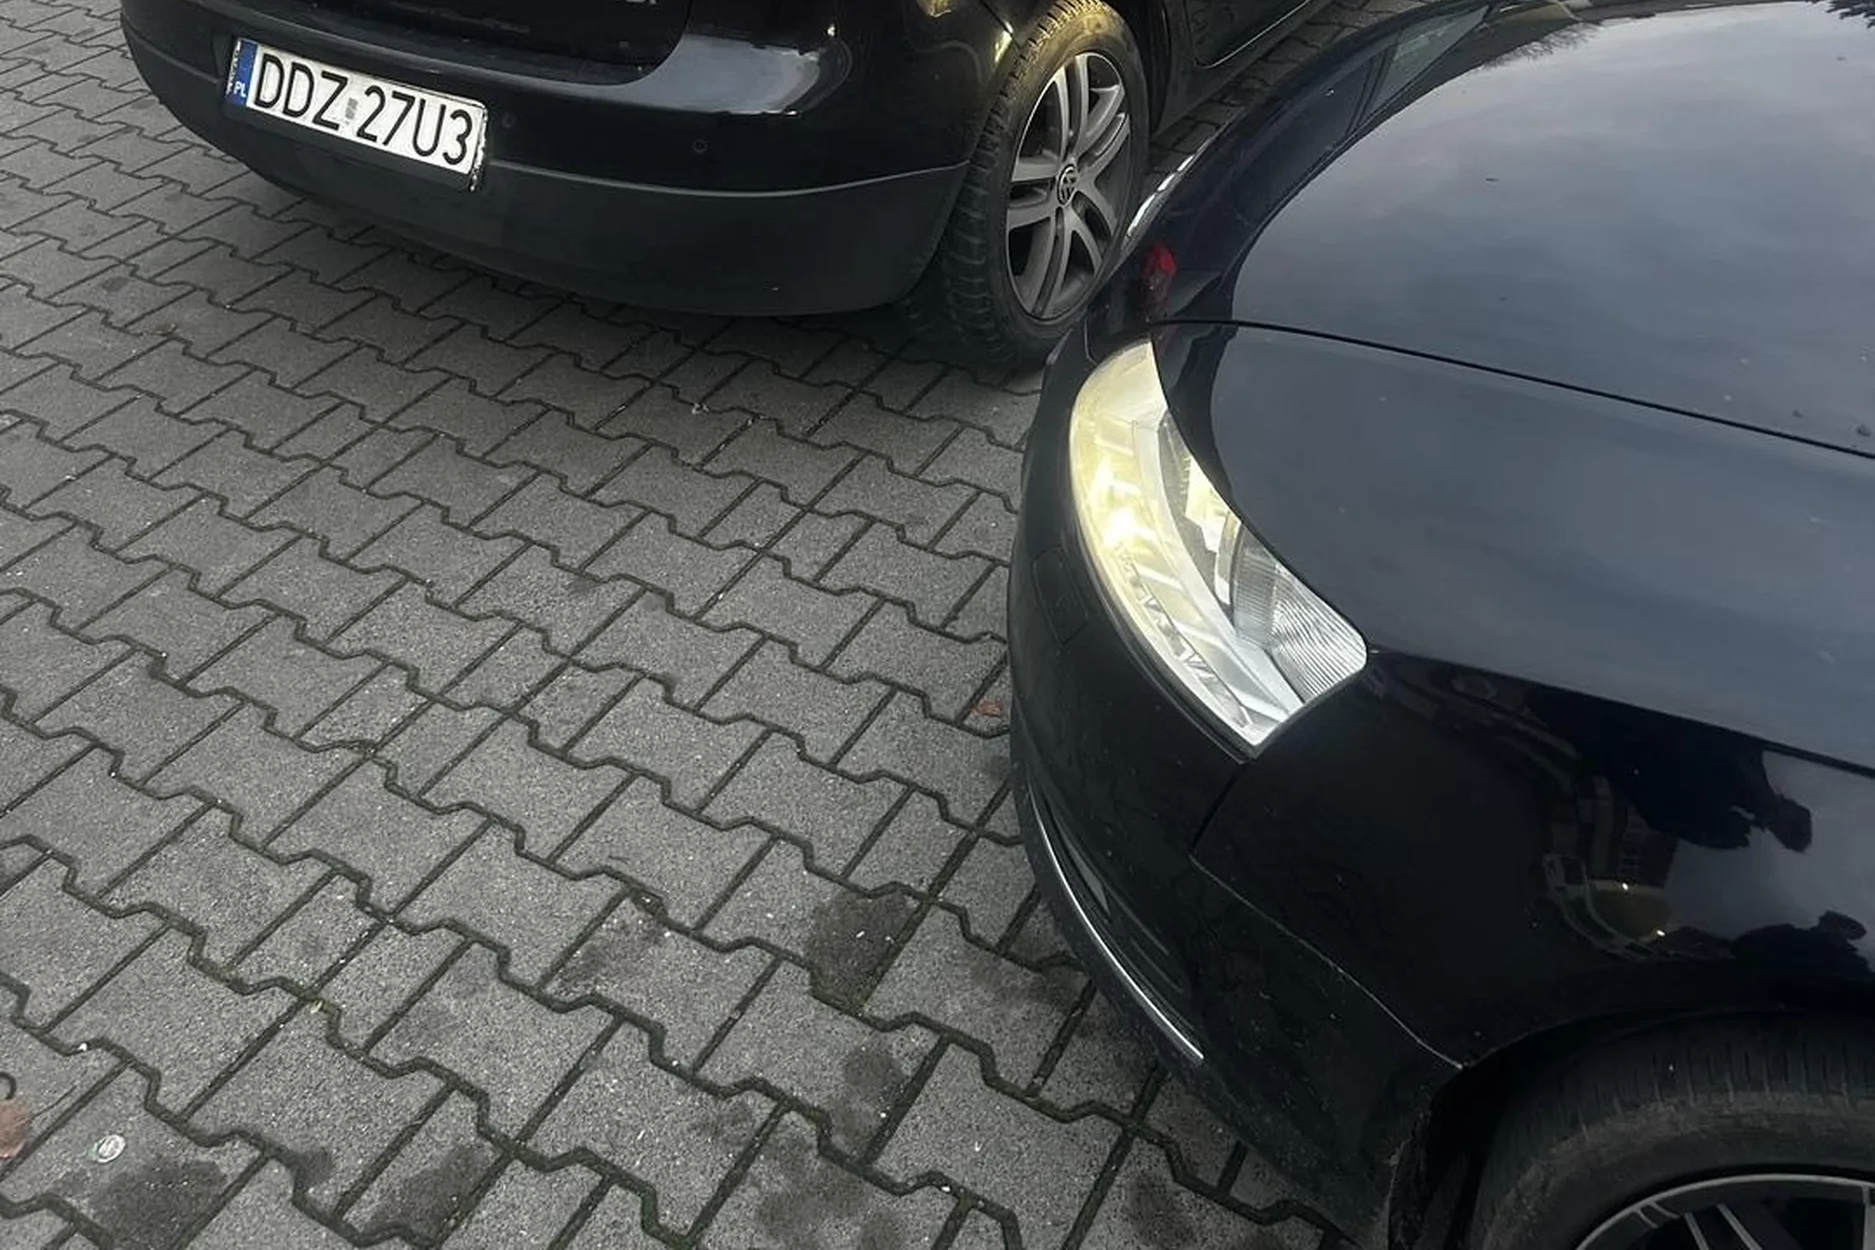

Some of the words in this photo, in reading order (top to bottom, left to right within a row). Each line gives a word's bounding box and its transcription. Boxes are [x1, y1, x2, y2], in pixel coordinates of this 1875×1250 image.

[234, 80, 247, 98] PL
[254, 53, 348, 131] DDZ
[356, 85, 473, 165] 27U3
